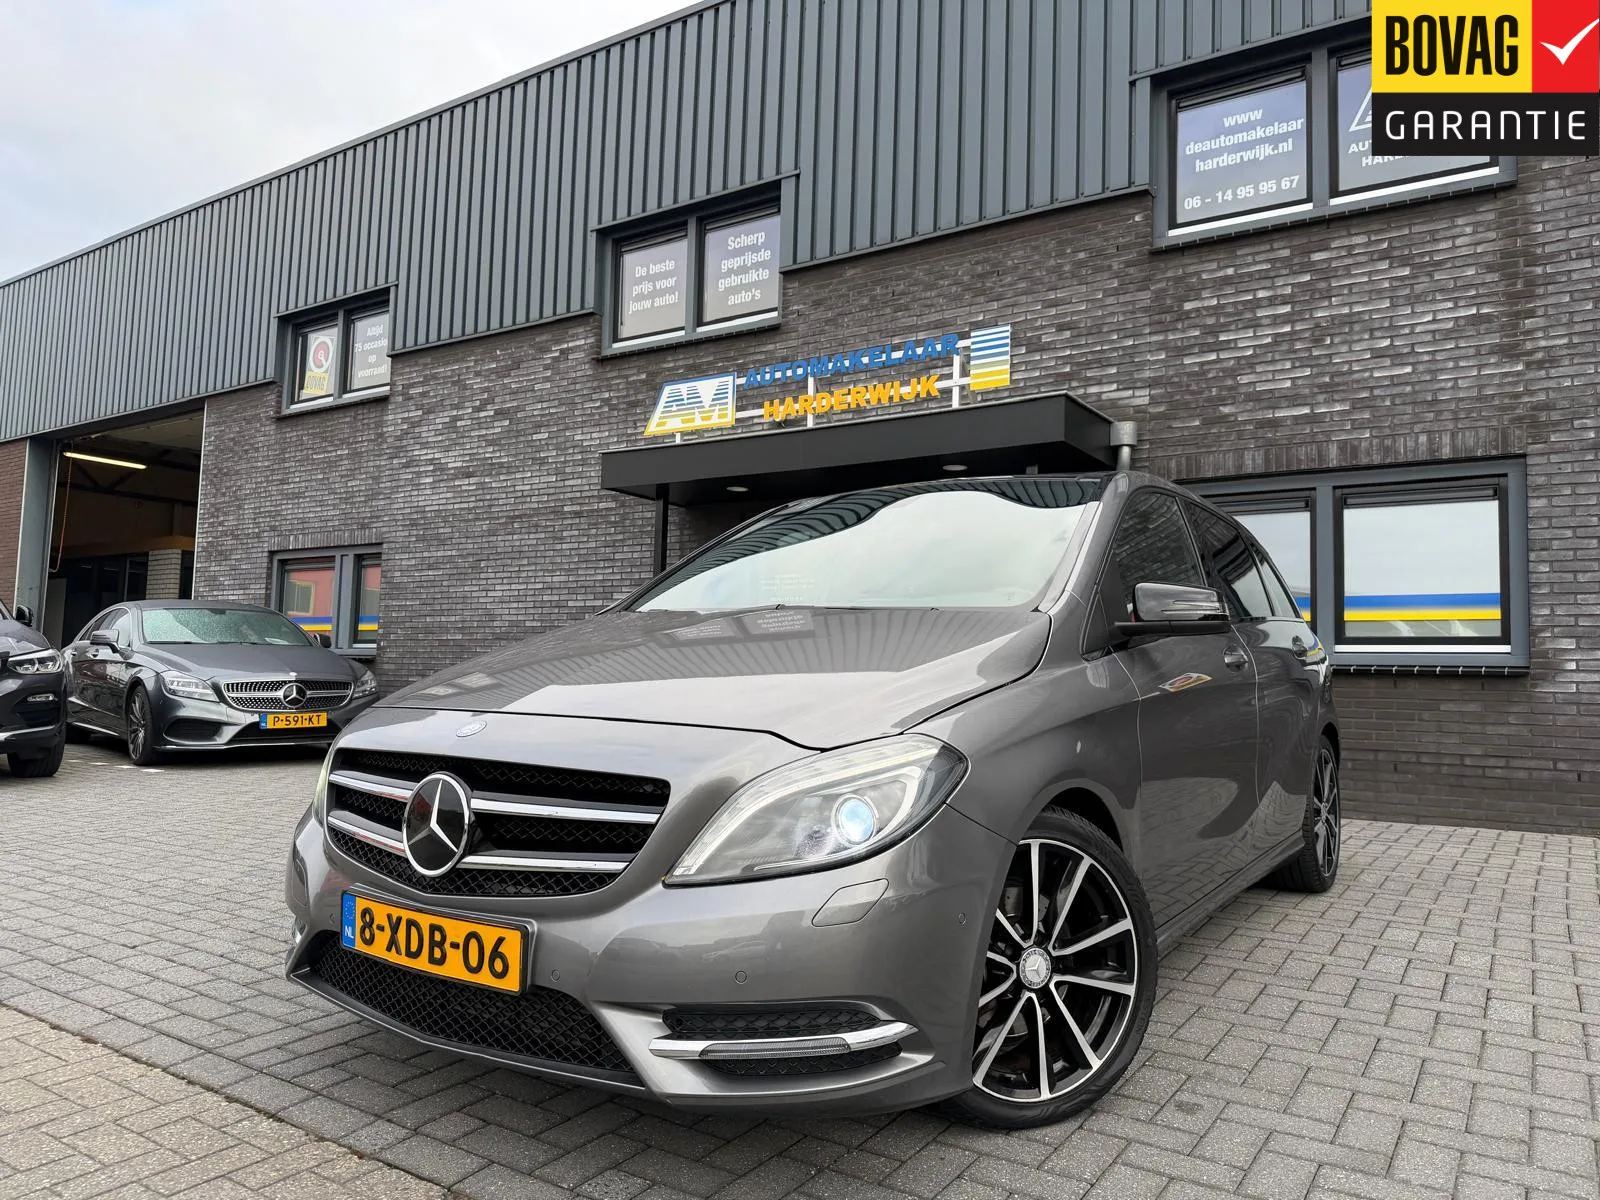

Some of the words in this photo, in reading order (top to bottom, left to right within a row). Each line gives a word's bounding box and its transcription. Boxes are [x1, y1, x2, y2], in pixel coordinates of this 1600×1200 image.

[1223, 108, 1263, 128] www
[1185, 118, 1304, 155] deautomakelaar
[1195, 138, 1293, 172] harderwijk.nl
[1184, 195, 1202, 209] 06
[1216, 189, 1233, 203] 14
[1236, 184, 1255, 199] 95
[1258, 180, 1277, 194] 95
[1281, 175, 1299, 190] 67
[727, 231, 766, 250] Scherp
[635, 265, 647, 278] De
[649, 258, 675, 275] beste
[720, 248, 771, 272] geprijsde
[632, 280, 653, 297] prijs
[655, 275, 677, 290] voor
[718, 267, 770, 291] gebruikte
[628, 297, 652, 314] jouw
[653, 291, 679, 308] auto!
[728, 289, 761, 306] auto's
[354, 343, 363, 353] 75
[363, 338, 388, 351] occasio
[368, 354, 377, 364] op
[743, 333, 960, 389] AUTOMAKELAAR
[763, 374, 940, 422] HARDERWIJK
[273, 714, 322, 727] P-591-KT
[344, 926, 354, 939] NL
[359, 907, 509, 980] 8-XDB-06
